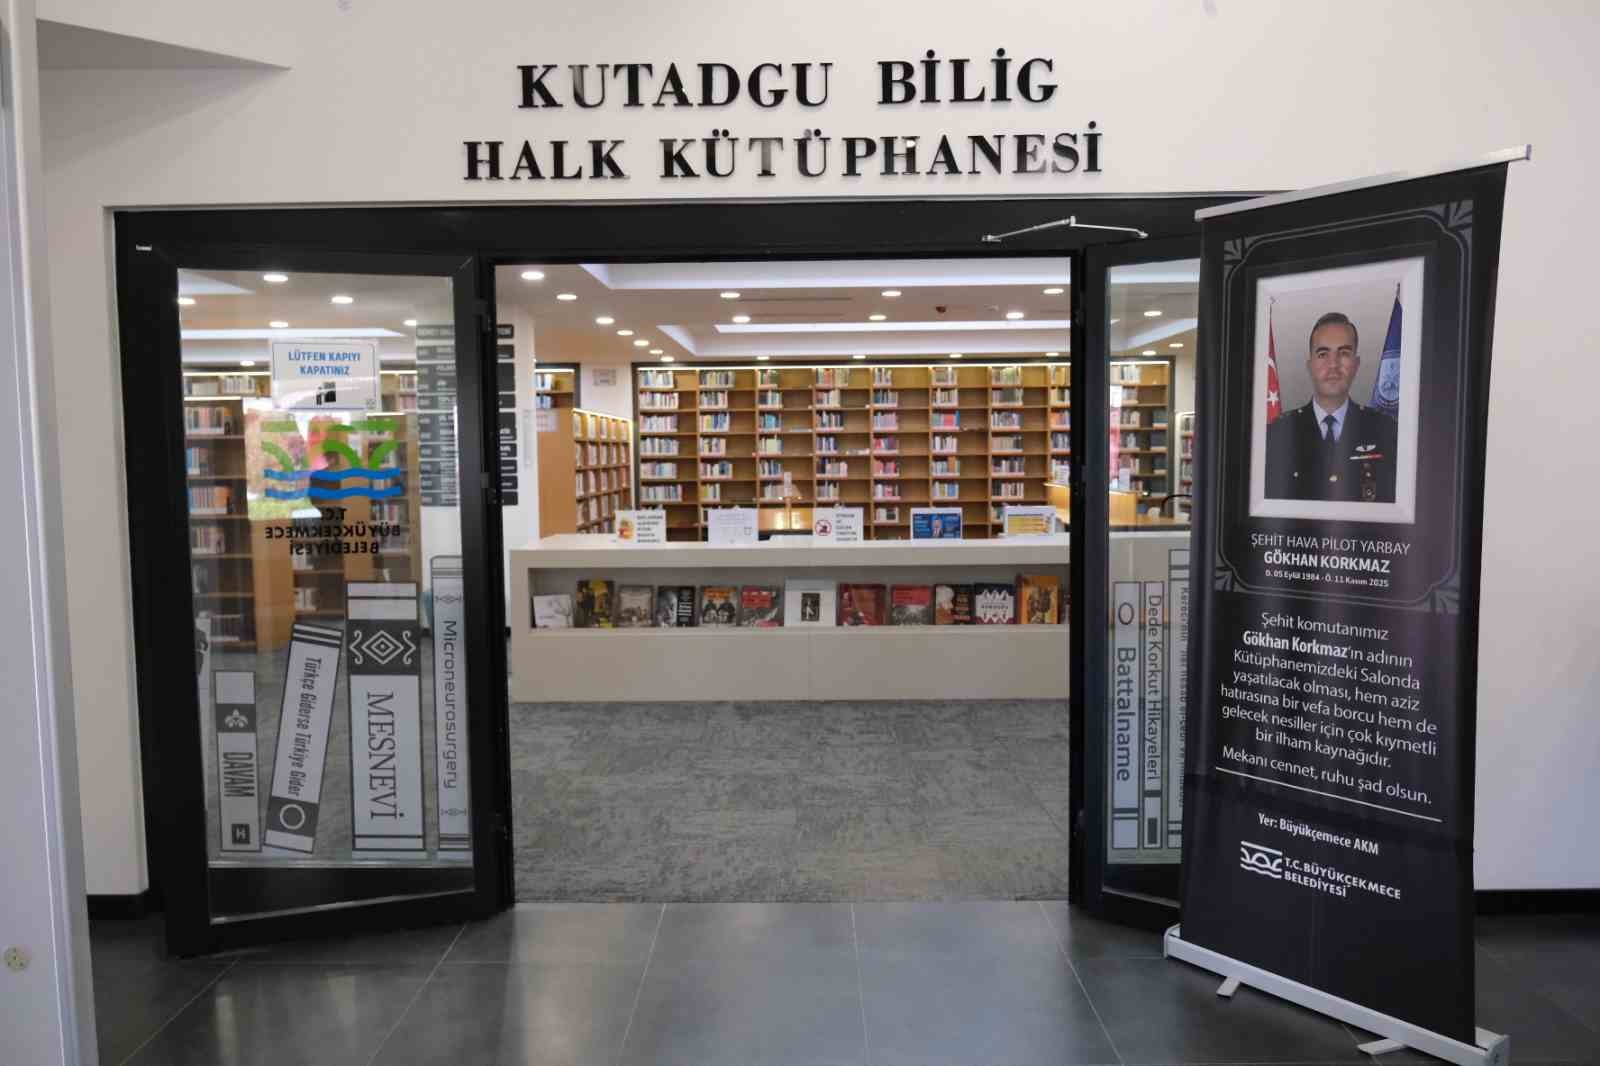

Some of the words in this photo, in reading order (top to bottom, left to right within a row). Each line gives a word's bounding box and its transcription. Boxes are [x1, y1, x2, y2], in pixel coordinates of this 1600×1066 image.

[516, 62, 833, 108] KUTADGU
[877, 48, 1058, 104] BİLİG
[462, 139, 631, 181] HALK
[659, 120, 1103, 180] KÜTÜPHANESİ
[288, 349, 325, 361] LÜTFEN
[328, 351, 361, 362] KAPIYI
[299, 365, 350, 377] KAPATINIZ
[1264, 550, 1318, 568] GÖKHAN
[1319, 554, 1391, 574] KORKMAZ
[1286, 534, 1319, 549] HAVA
[1321, 535, 1358, 551] PİLOT
[1359, 539, 1411, 556] YARBAY
[1148, 594, 1162, 637] Dede
[1261, 612, 1294, 629] Şehit
[1297, 616, 1390, 640] komutanımız
[1148, 640, 1162, 696] Korkut
[1233, 648, 1357, 680] Kütüphanemizdeki
[1360, 668, 1420, 690] Salonda
[1243, 631, 1289, 650] Gökhan
[1367, 650, 1413, 667] adının
[302, 657, 322, 691] Türkçe
[1233, 671, 1301, 691] yaşatılacak
[1303, 680, 1351, 701] olması,
[1355, 686, 1387, 705] hem
[1391, 695, 1420, 712] aziz
[296, 692, 317, 730] Giderse
[442, 620, 457, 790] Microneurosurgery
[1116, 647, 1137, 782] Battalname
[1221, 683, 1279, 706] hatırasına
[1282, 694, 1300, 709] bir
[1302, 701, 1330, 716] vefa
[1334, 703, 1374, 723] borcu
[1378, 711, 1412, 731] hem
[1416, 718, 1438, 735] de
[289, 732, 312, 769] Türkiye
[1145, 699, 1161, 781] Hikayeleri
[1222, 705, 1269, 723] gelecek
[1271, 715, 1317, 733] nesiller
[1320, 721, 1344, 739] için
[1347, 728, 1372, 743] çok
[1376, 730, 1437, 756] kıymetli
[1255, 727, 1273, 742] bir
[1275, 731, 1311, 752] ilham
[1315, 739, 1392, 768] kaynağıdır.
[223, 751, 255, 798] DAVAM
[367, 691, 405, 821] MESNEVİ
[1222, 745, 1268, 768] Mekanı
[1270, 759, 1318, 780] cennet,
[1321, 768, 1354, 786] ruhu
[1358, 779, 1382, 793] şad
[1386, 783, 1432, 805] olsun.
[288, 770, 307, 797] Gider
[1258, 812, 1278, 829] Yer:
[1279, 819, 1352, 848] Büyükçemece
[1353, 839, 1379, 855] AKM
[1284, 870, 1347, 897] BELEDİYESİ
[1302, 861, 1400, 900] BÜYÜKÇEKMECE
